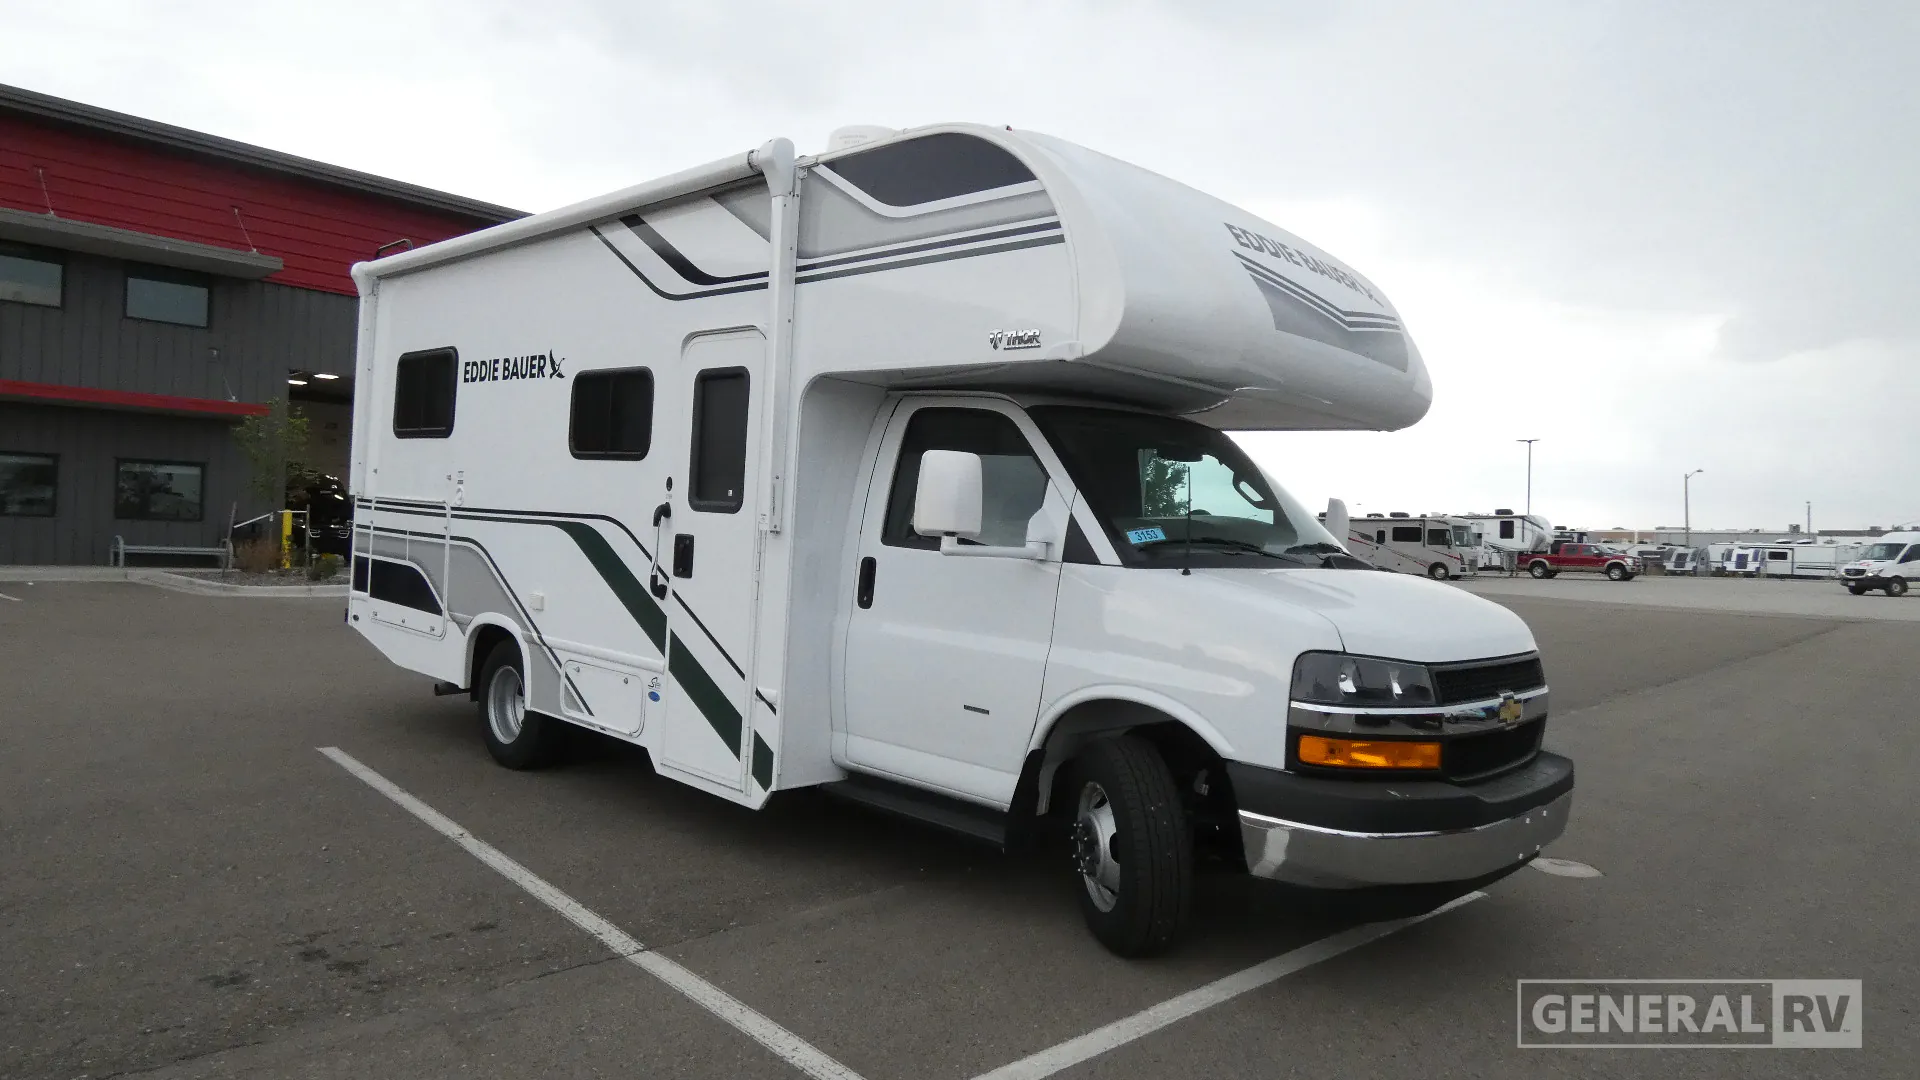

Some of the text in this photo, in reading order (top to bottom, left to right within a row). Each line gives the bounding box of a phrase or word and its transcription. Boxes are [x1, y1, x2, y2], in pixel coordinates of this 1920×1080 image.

[1224, 222, 1364, 295] EDDIE BAUER
[1003, 329, 1041, 346] THOR
[463, 354, 547, 383] EDDIE BAUER
[1135, 529, 1159, 542] 3153
